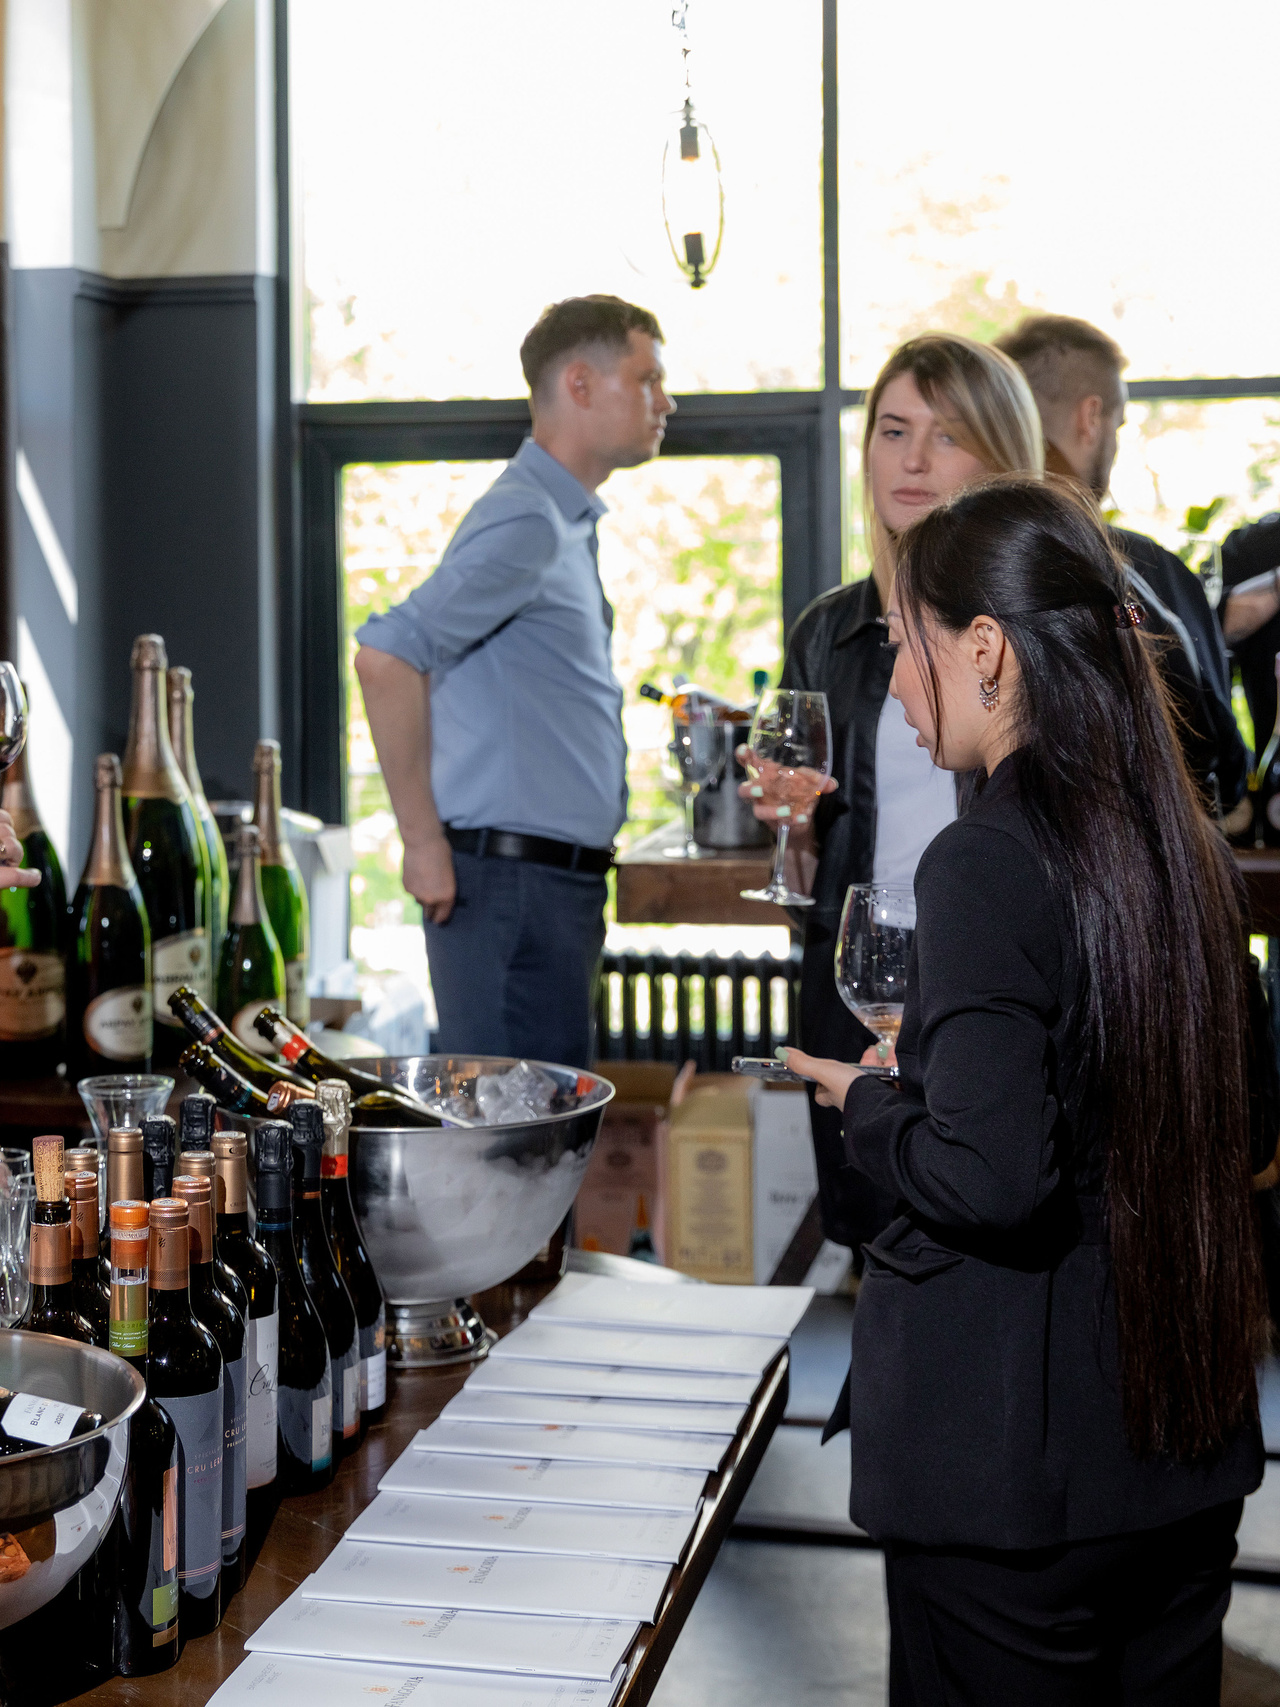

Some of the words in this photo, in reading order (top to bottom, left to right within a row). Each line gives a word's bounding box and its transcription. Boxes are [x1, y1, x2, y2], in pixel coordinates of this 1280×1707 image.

[30, 1406, 46, 1426] BLANC
[224, 1426, 240, 1438] CRU
[187, 1463, 206, 1474] CRU
[469, 1555, 499, 1585] FANAGORIA
[422, 1608, 460, 1639] FANAGORIA
